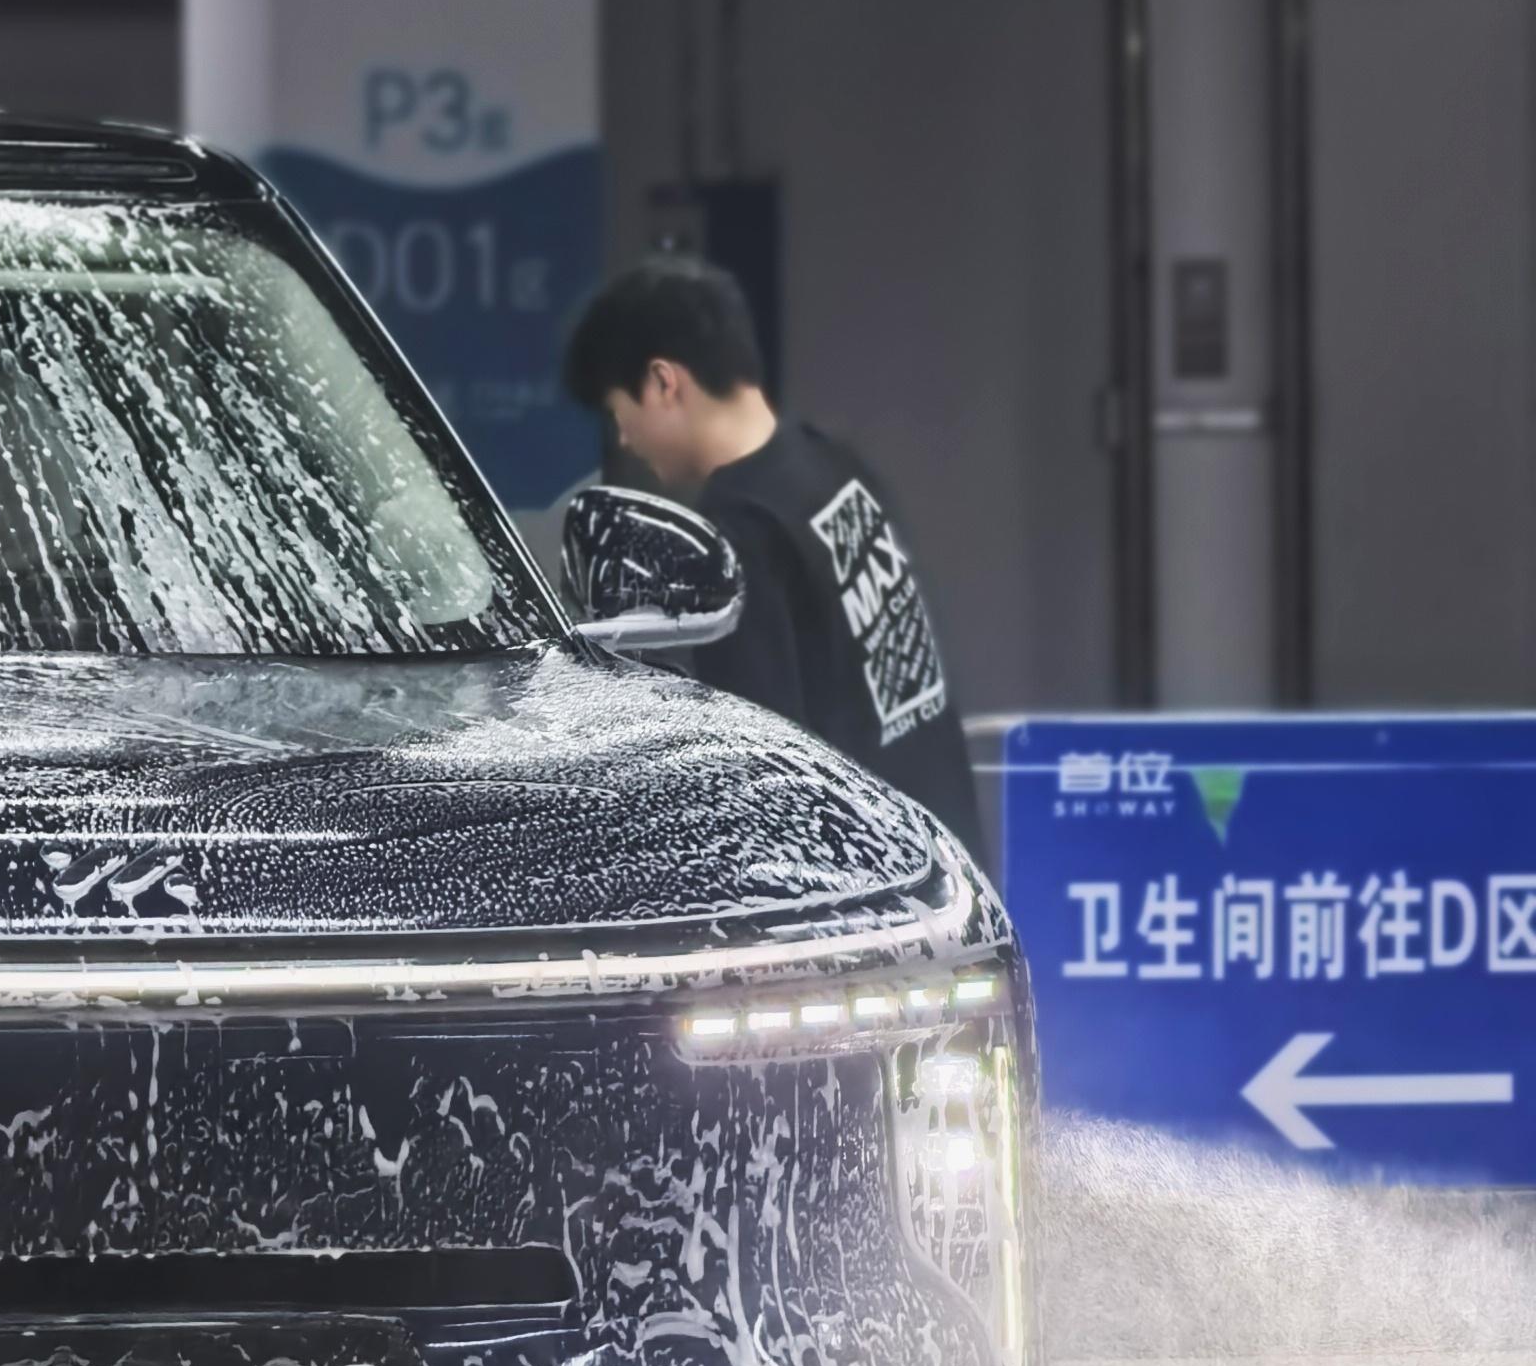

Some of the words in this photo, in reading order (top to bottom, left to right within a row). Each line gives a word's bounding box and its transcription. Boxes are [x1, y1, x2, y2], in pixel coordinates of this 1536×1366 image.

[841, 522, 907, 638] MAX
[1059, 751, 1174, 793] 首位
[1062, 871, 1536, 981] 卫生间前往D区
